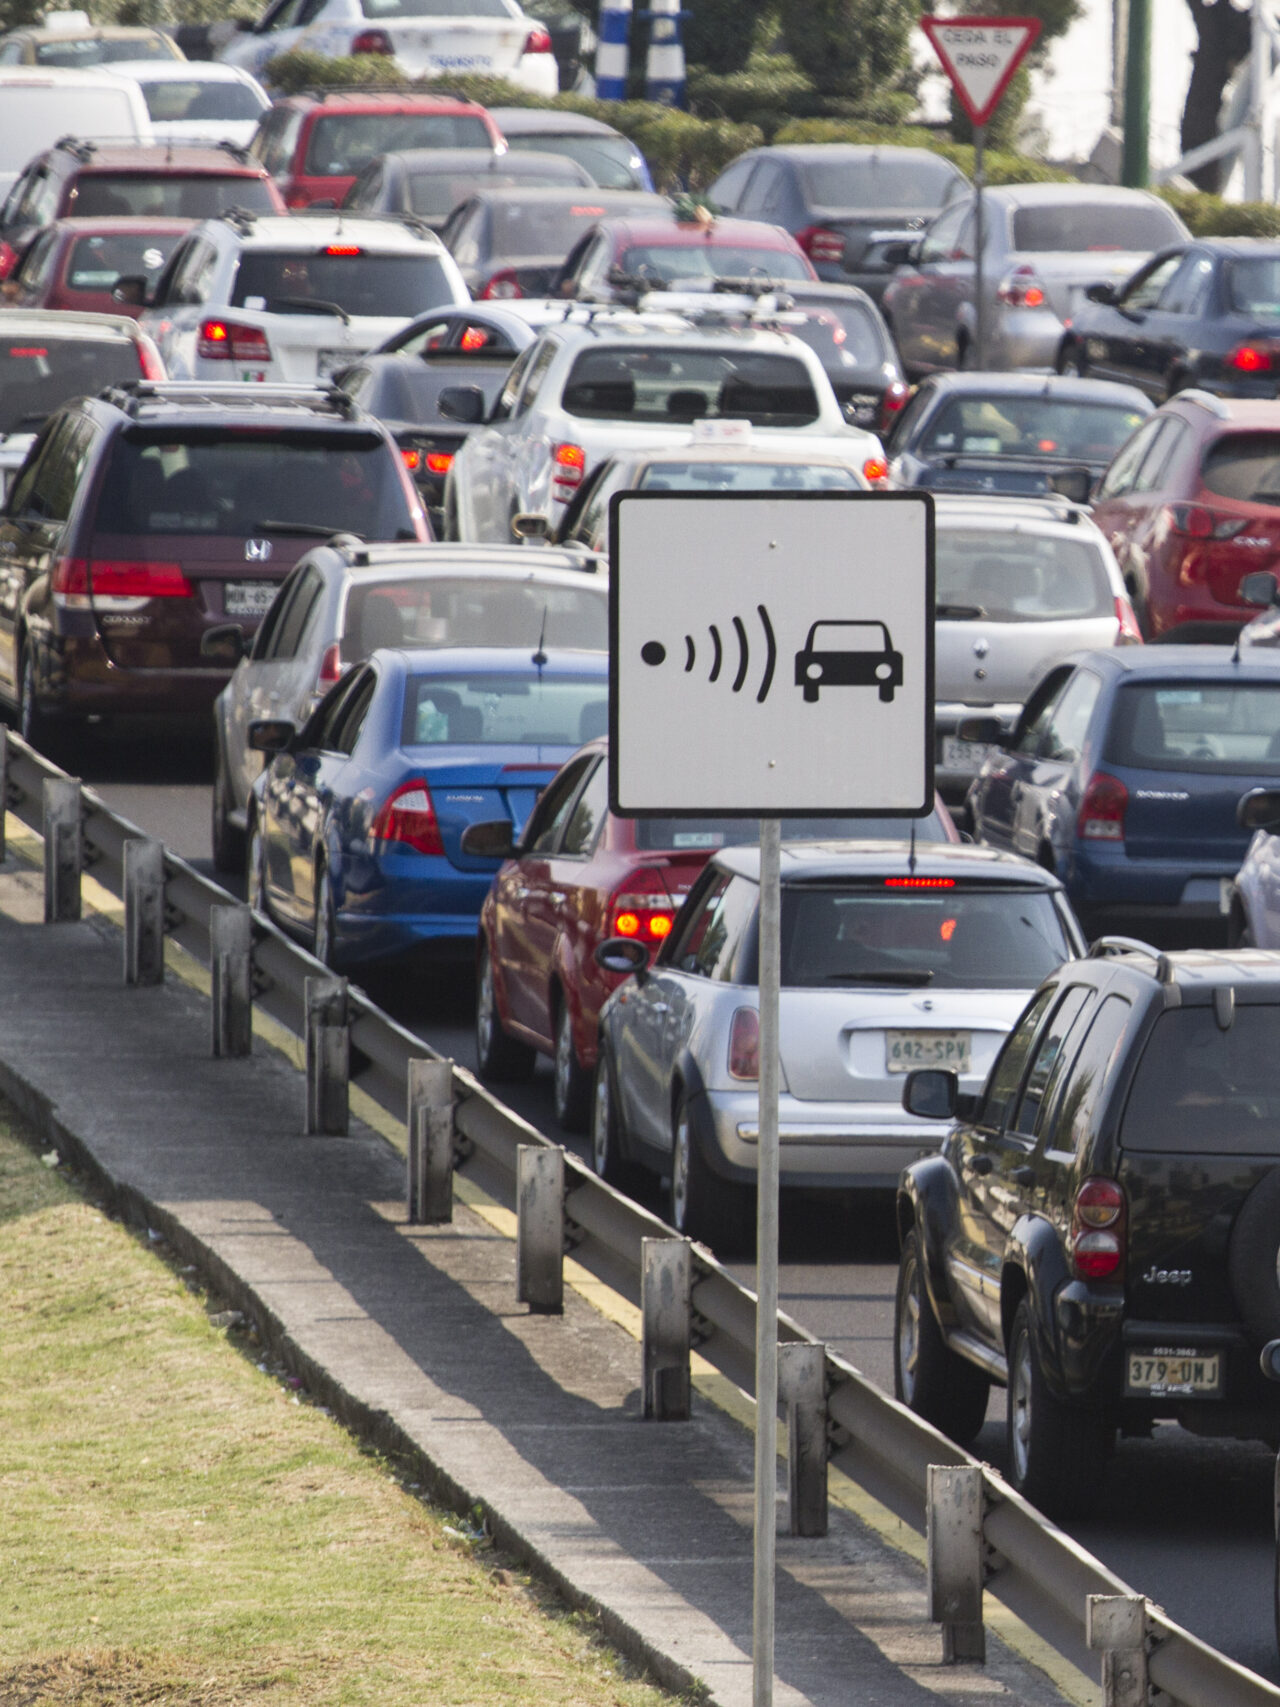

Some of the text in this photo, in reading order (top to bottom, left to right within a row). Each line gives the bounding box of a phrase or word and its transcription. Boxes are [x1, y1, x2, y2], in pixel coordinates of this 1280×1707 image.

[943, 29, 1012, 44] CEDA EL
[956, 53, 999, 67] PASO
[892, 1041, 965, 1060] 642-SPV
[1142, 1265, 1192, 1287] Jeep
[1131, 1361, 1218, 1384] 379-UMJ
